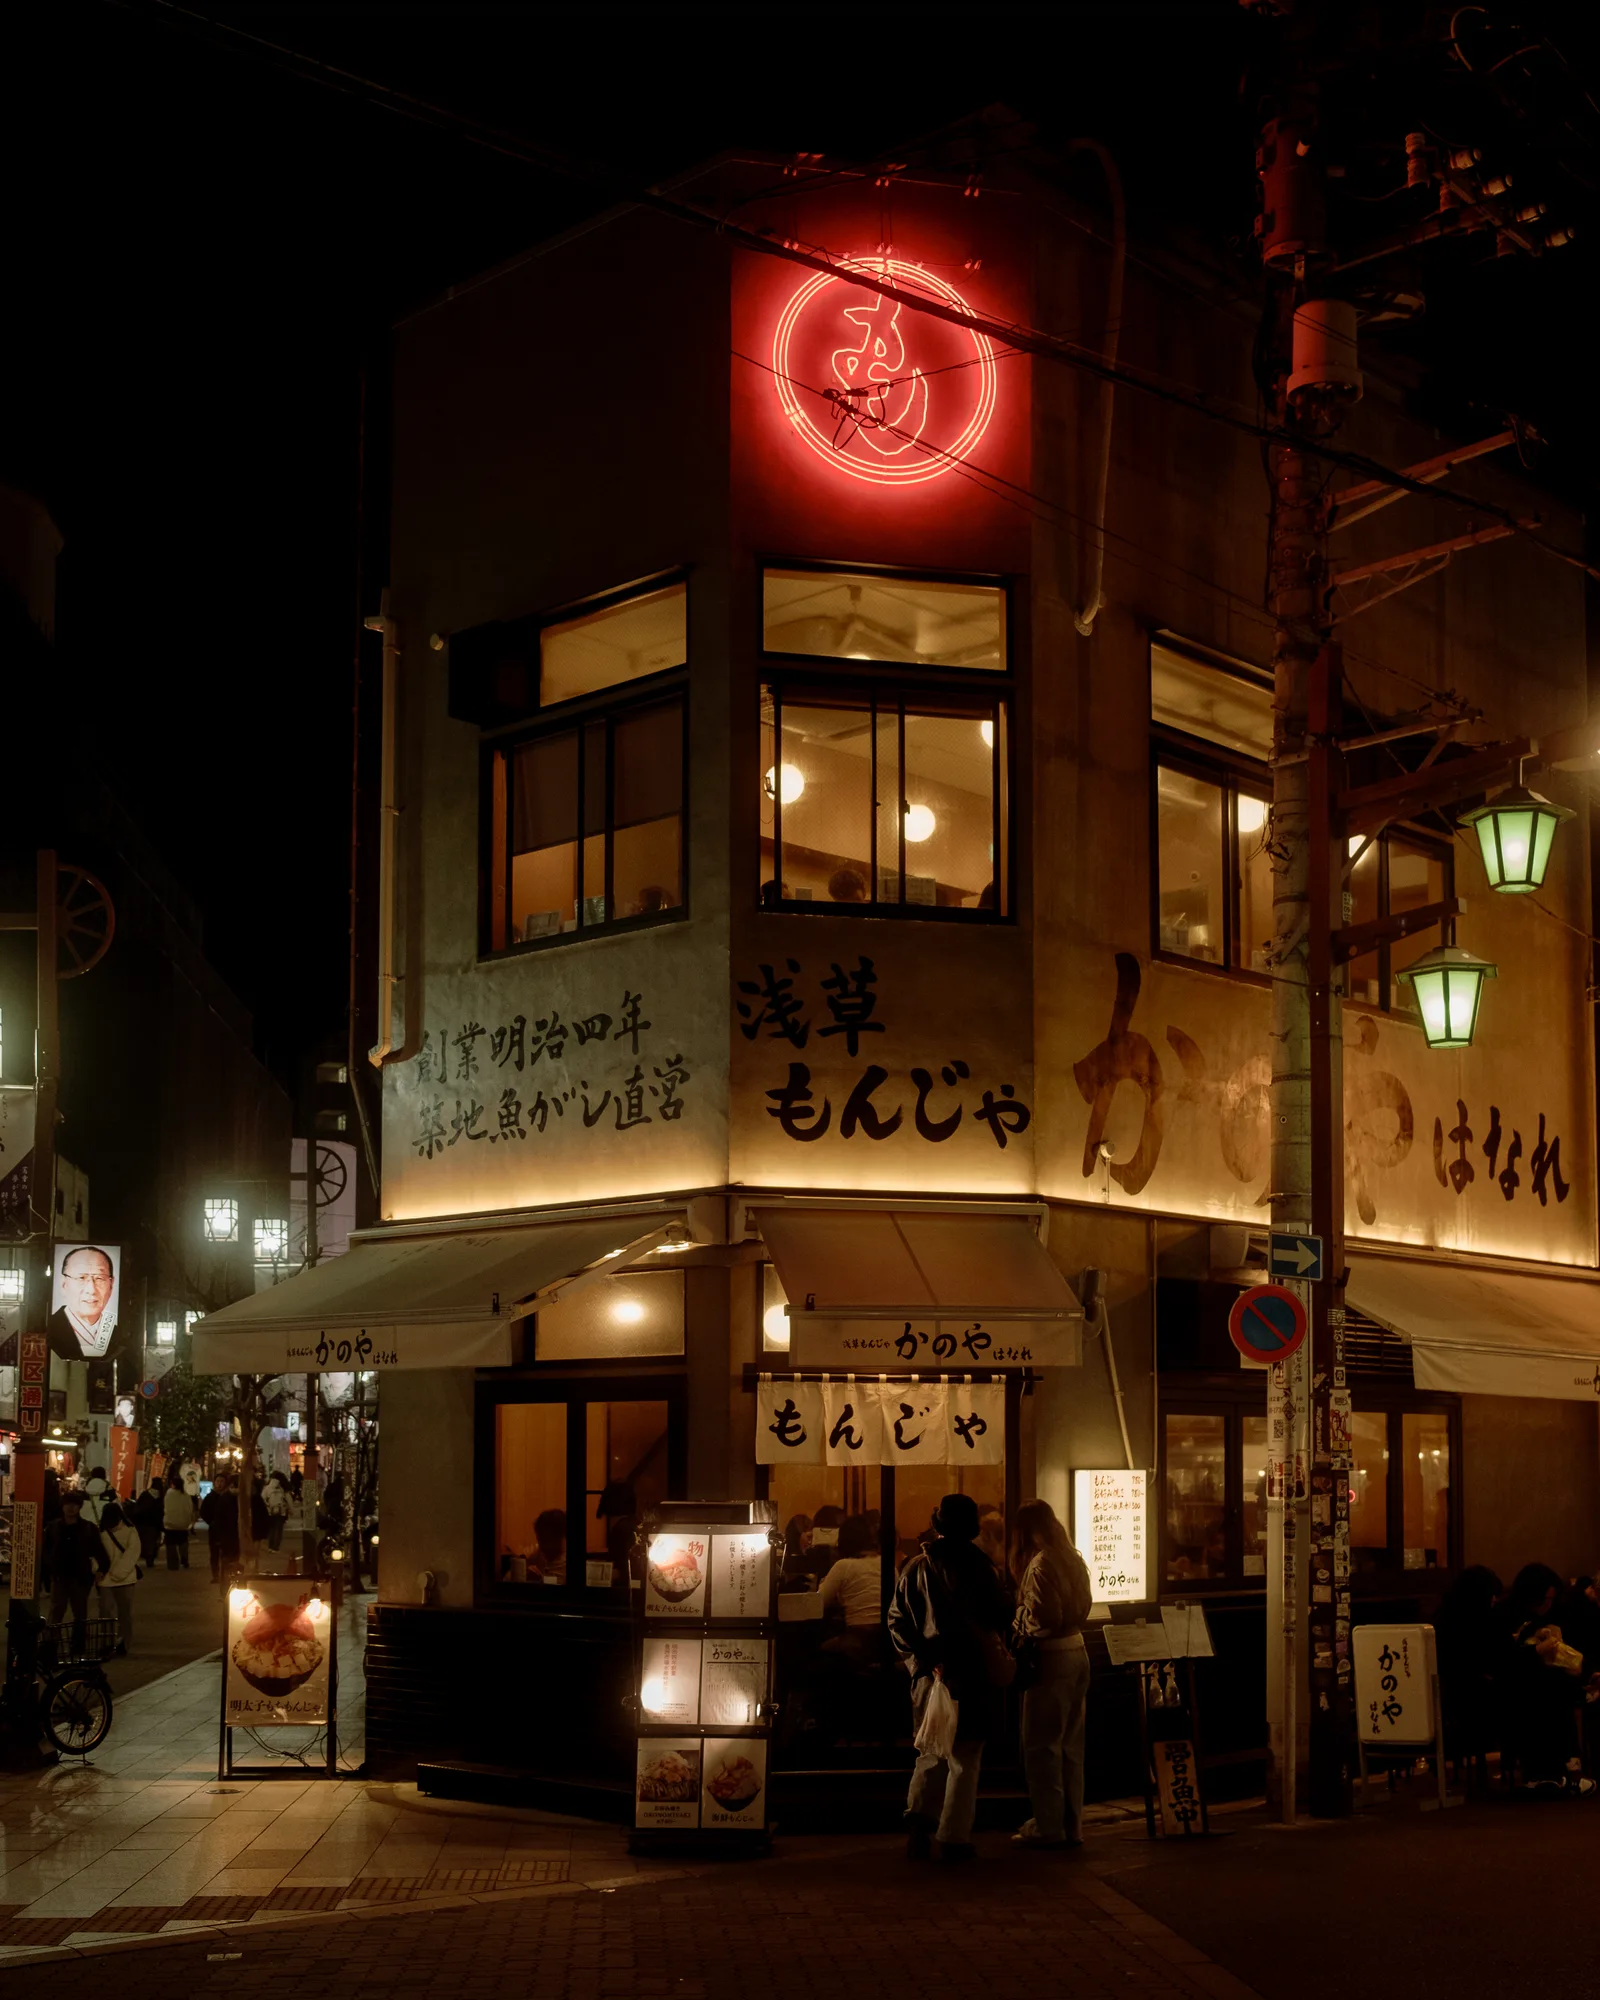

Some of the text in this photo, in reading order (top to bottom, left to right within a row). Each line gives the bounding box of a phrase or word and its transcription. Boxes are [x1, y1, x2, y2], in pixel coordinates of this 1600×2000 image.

[412, 990, 652, 1090] 創業明治四年
[737, 955, 886, 1057] 浅草
[411, 1053, 691, 1160] 築地魚がし直営
[765, 1060, 1031, 1149] もんじゃ
[1433, 1098, 1570, 1207] はなれ
[315, 1328, 373, 1366] かのや
[373, 1350, 398, 1364] はなれ
[842, 1322, 1033, 1362] 浅草もんじゃ かのや はなれ
[20, 1333, 47, 1433] 六区通り
[769, 1398, 987, 1450] もんじゃ
[115, 1431, 130, 1499] スープカレー
[1099, 1570, 1126, 1588] かのや
[712, 1648, 743, 1660] かのや
[1378, 1644, 1402, 1725] かのや
[230, 1700, 321, 1712] 明太子もちもんじゃ
[1370, 1700, 1381, 1734] はなれ
